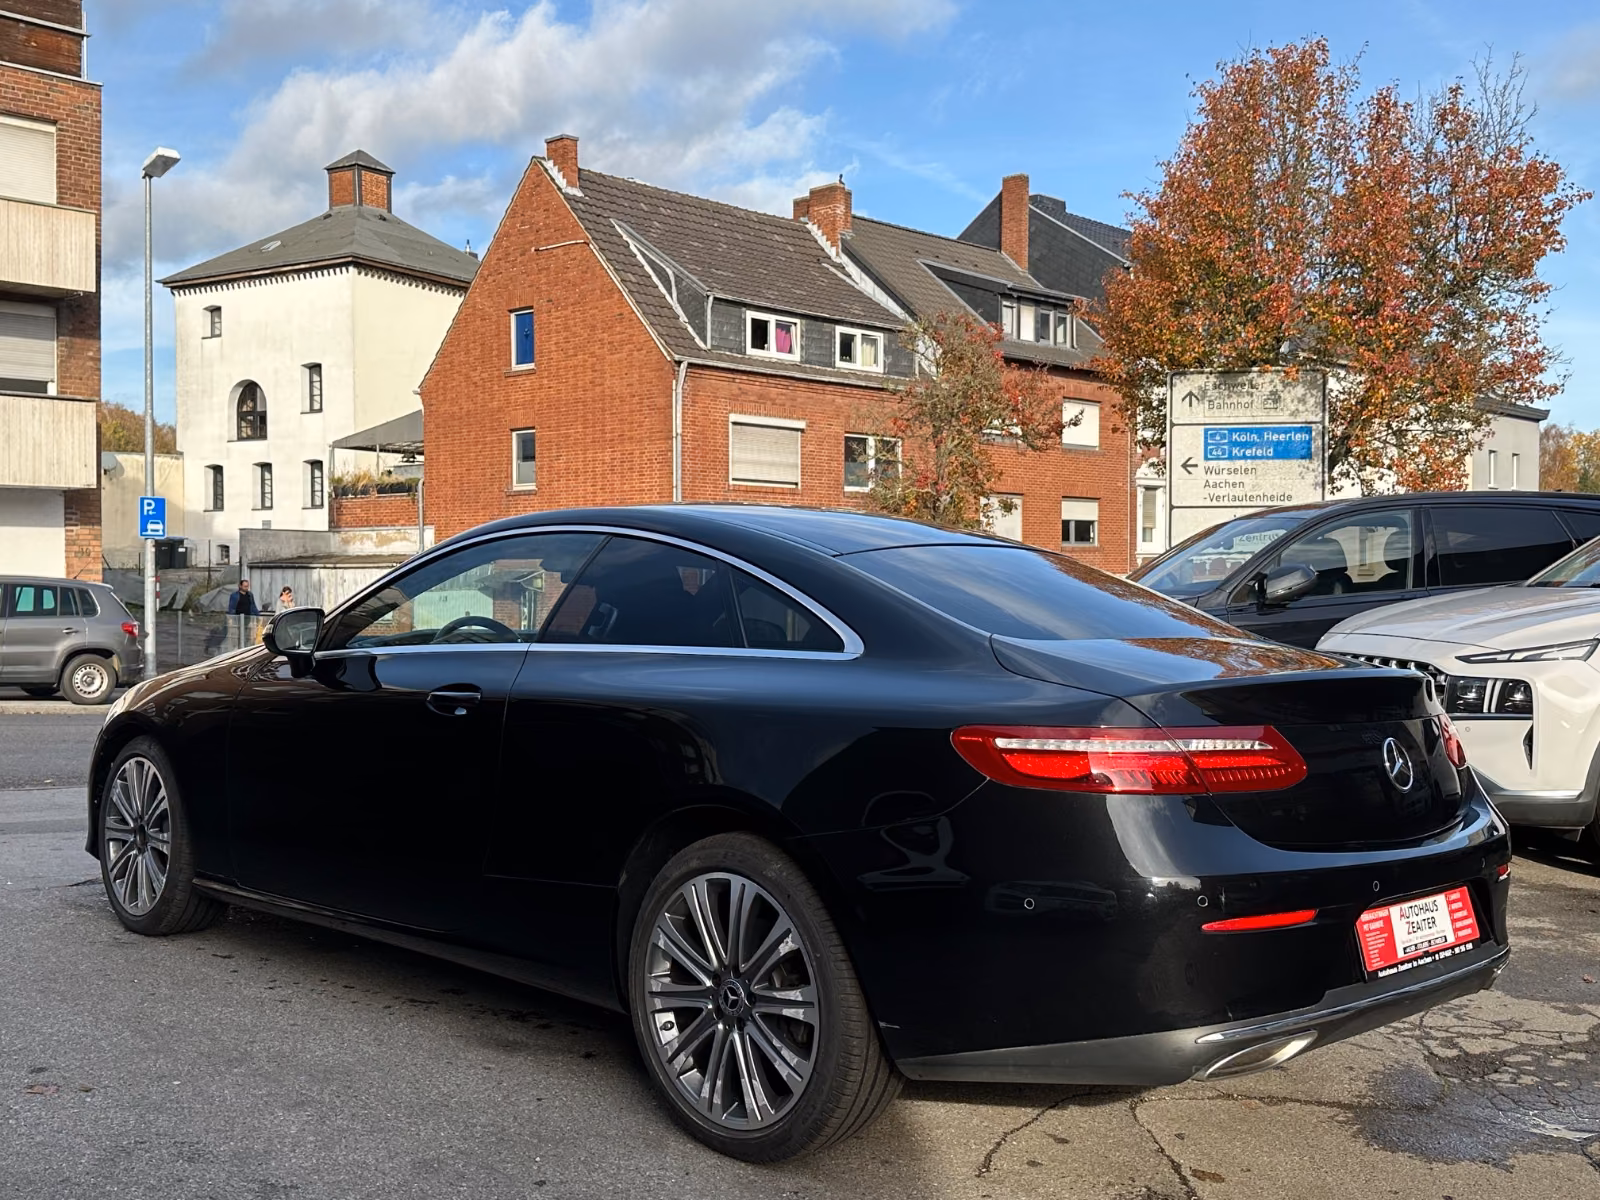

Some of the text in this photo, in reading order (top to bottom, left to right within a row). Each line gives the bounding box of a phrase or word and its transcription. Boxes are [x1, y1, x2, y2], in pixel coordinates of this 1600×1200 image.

[1207, 399, 1254, 410] Bahnhof
[1263, 430, 1310, 442] Heerlen
[1211, 447, 1223, 457] 44
[1231, 446, 1274, 457] Krefeld
[1203, 464, 1257, 475] Würselen
[1203, 479, 1245, 489] Aachen
[1203, 492, 1293, 503] -Verlautenheide
[143, 499, 156, 516] P
[1400, 899, 1439, 921] AUTOHAUS
[1406, 916, 1438, 936] ZEAITER
